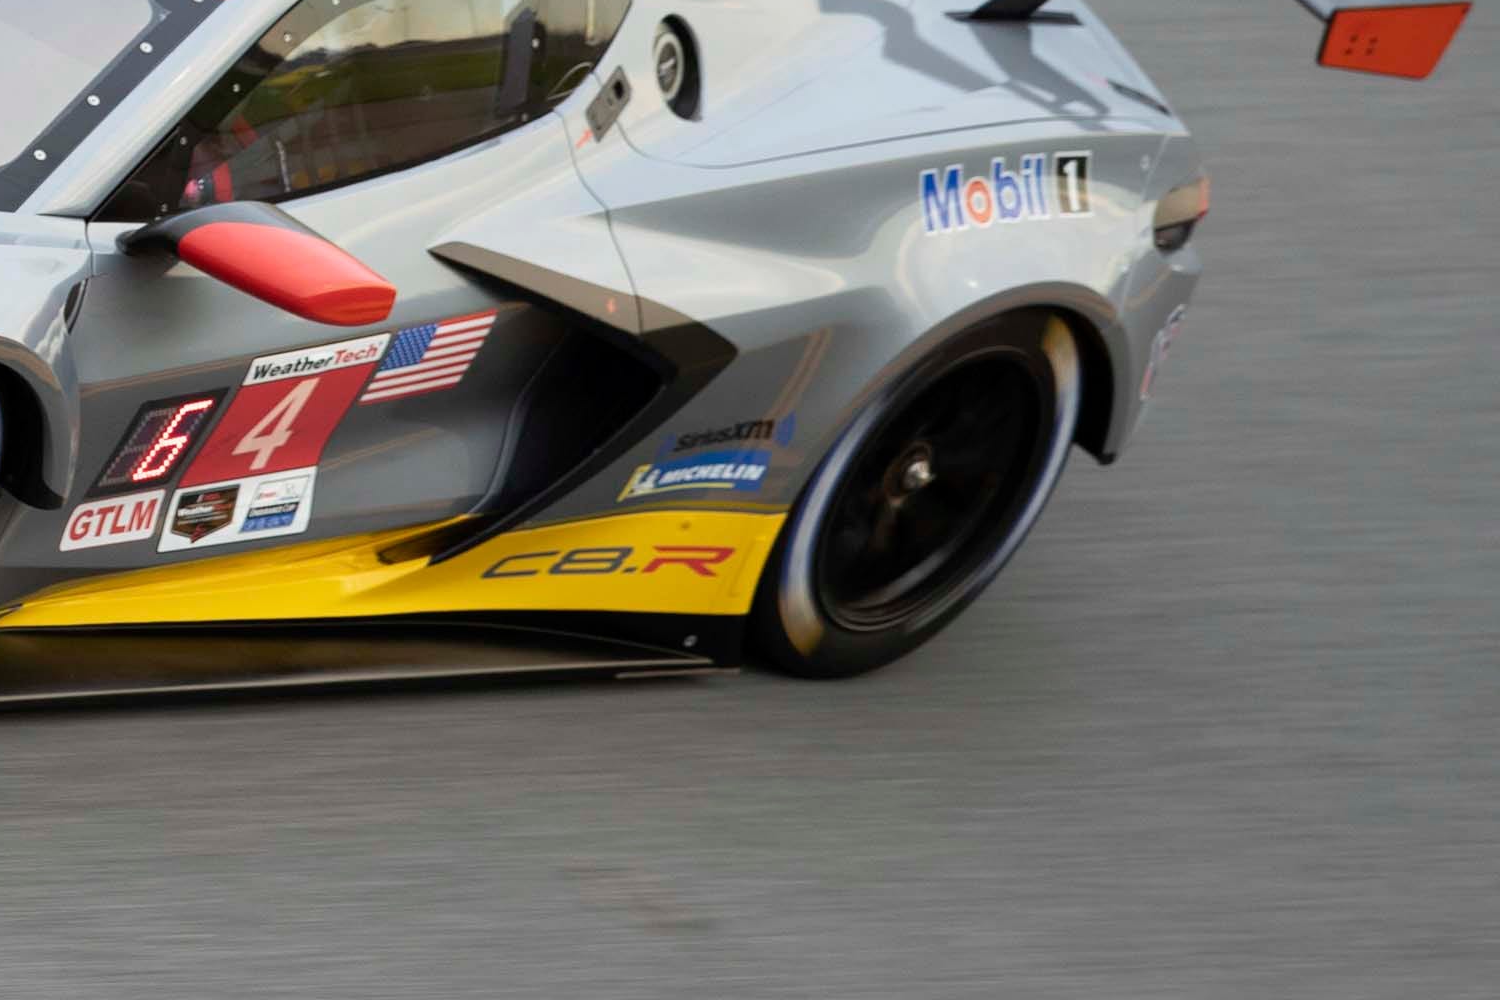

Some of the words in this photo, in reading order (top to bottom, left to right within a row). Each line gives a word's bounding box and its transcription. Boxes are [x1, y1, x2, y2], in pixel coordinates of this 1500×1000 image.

[920, 154, 1048, 233] Mobil
[252, 344, 378, 380] WeatherTech
[132, 399, 214, 481] 6
[232, 377, 320, 470] 4
[658, 464, 768, 485] MICHELIN
[69, 498, 158, 541] GTLM
[481, 546, 735, 579] C8.R
